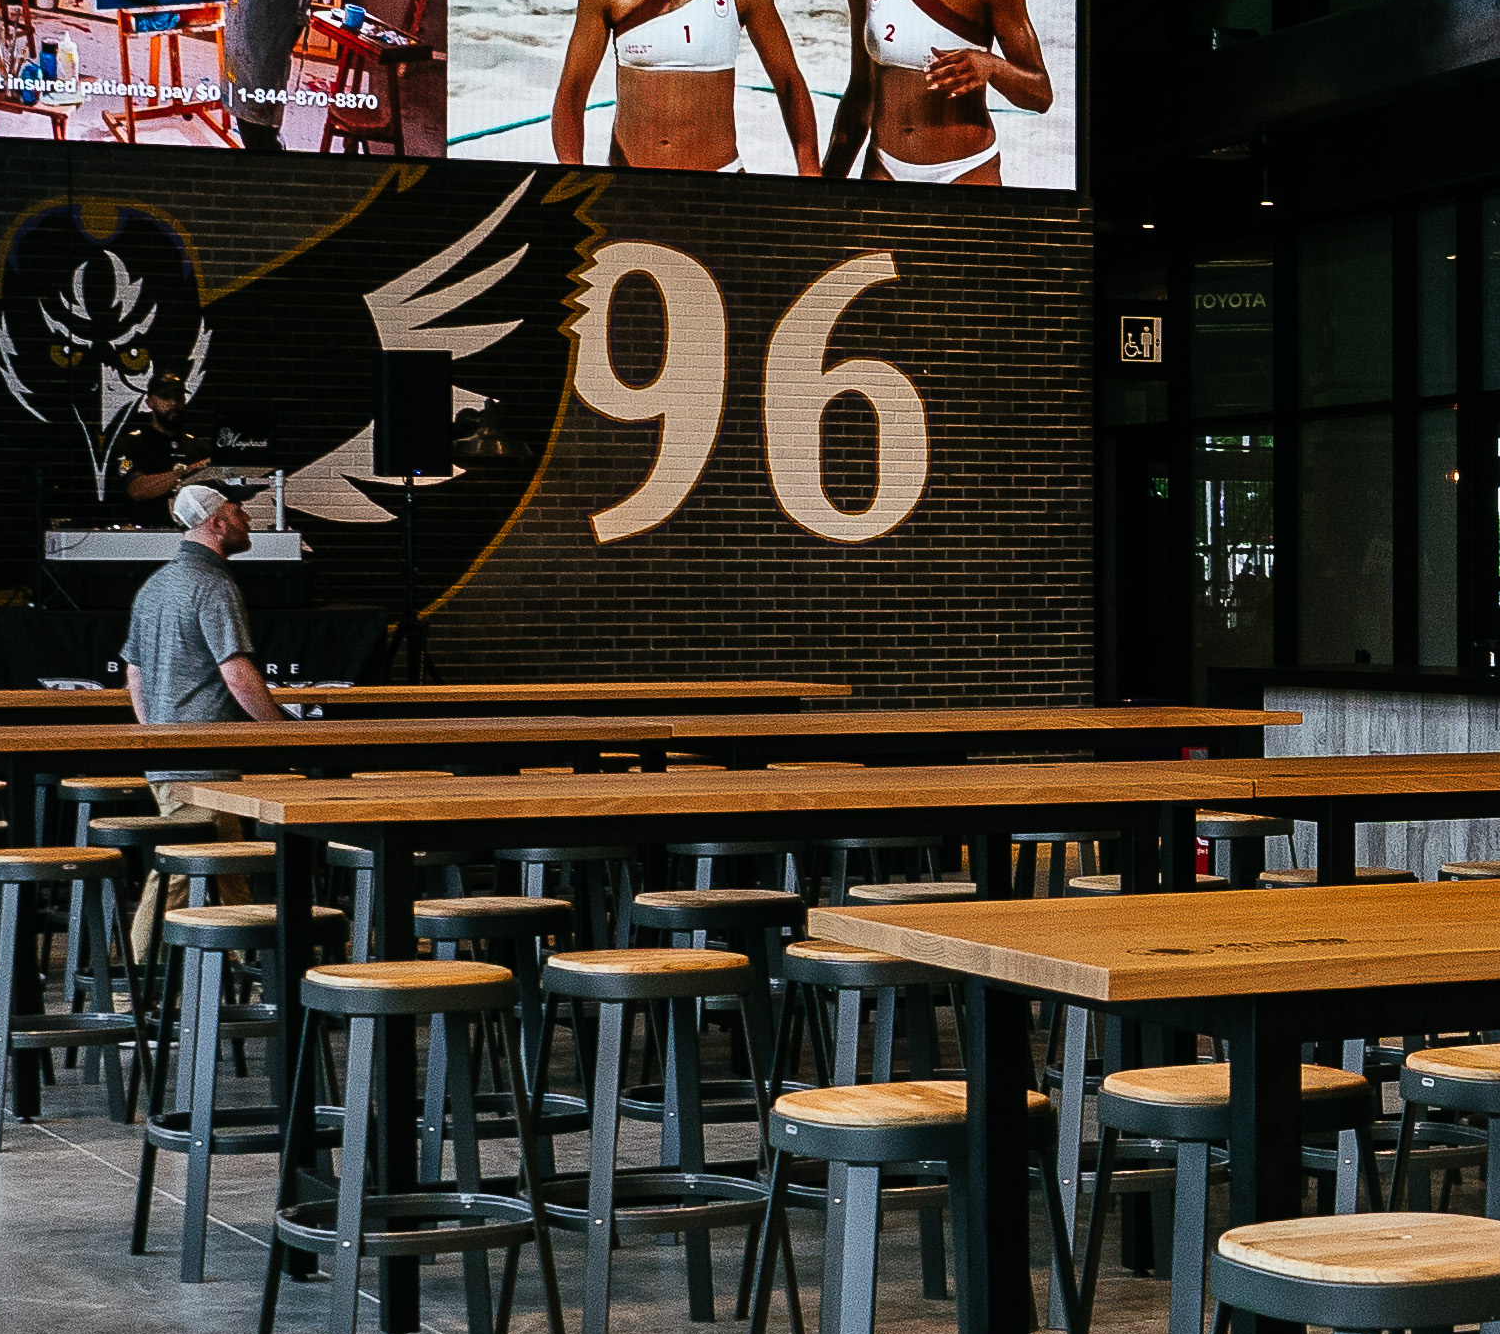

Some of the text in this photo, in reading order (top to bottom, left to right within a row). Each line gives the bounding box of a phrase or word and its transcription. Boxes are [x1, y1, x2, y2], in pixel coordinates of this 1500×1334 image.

[683, 24, 691, 44] 1
[883, 23, 896, 43] 2
[8, 73, 77, 93] insured
[81, 78, 157, 98] patients
[160, 86, 193, 104] pay
[196, 83, 222, 102] $0
[237, 87, 378, 110] 1-844-870-8870
[1194, 292, 1267, 310] TOYOTA
[567, 237, 931, 547] 96
